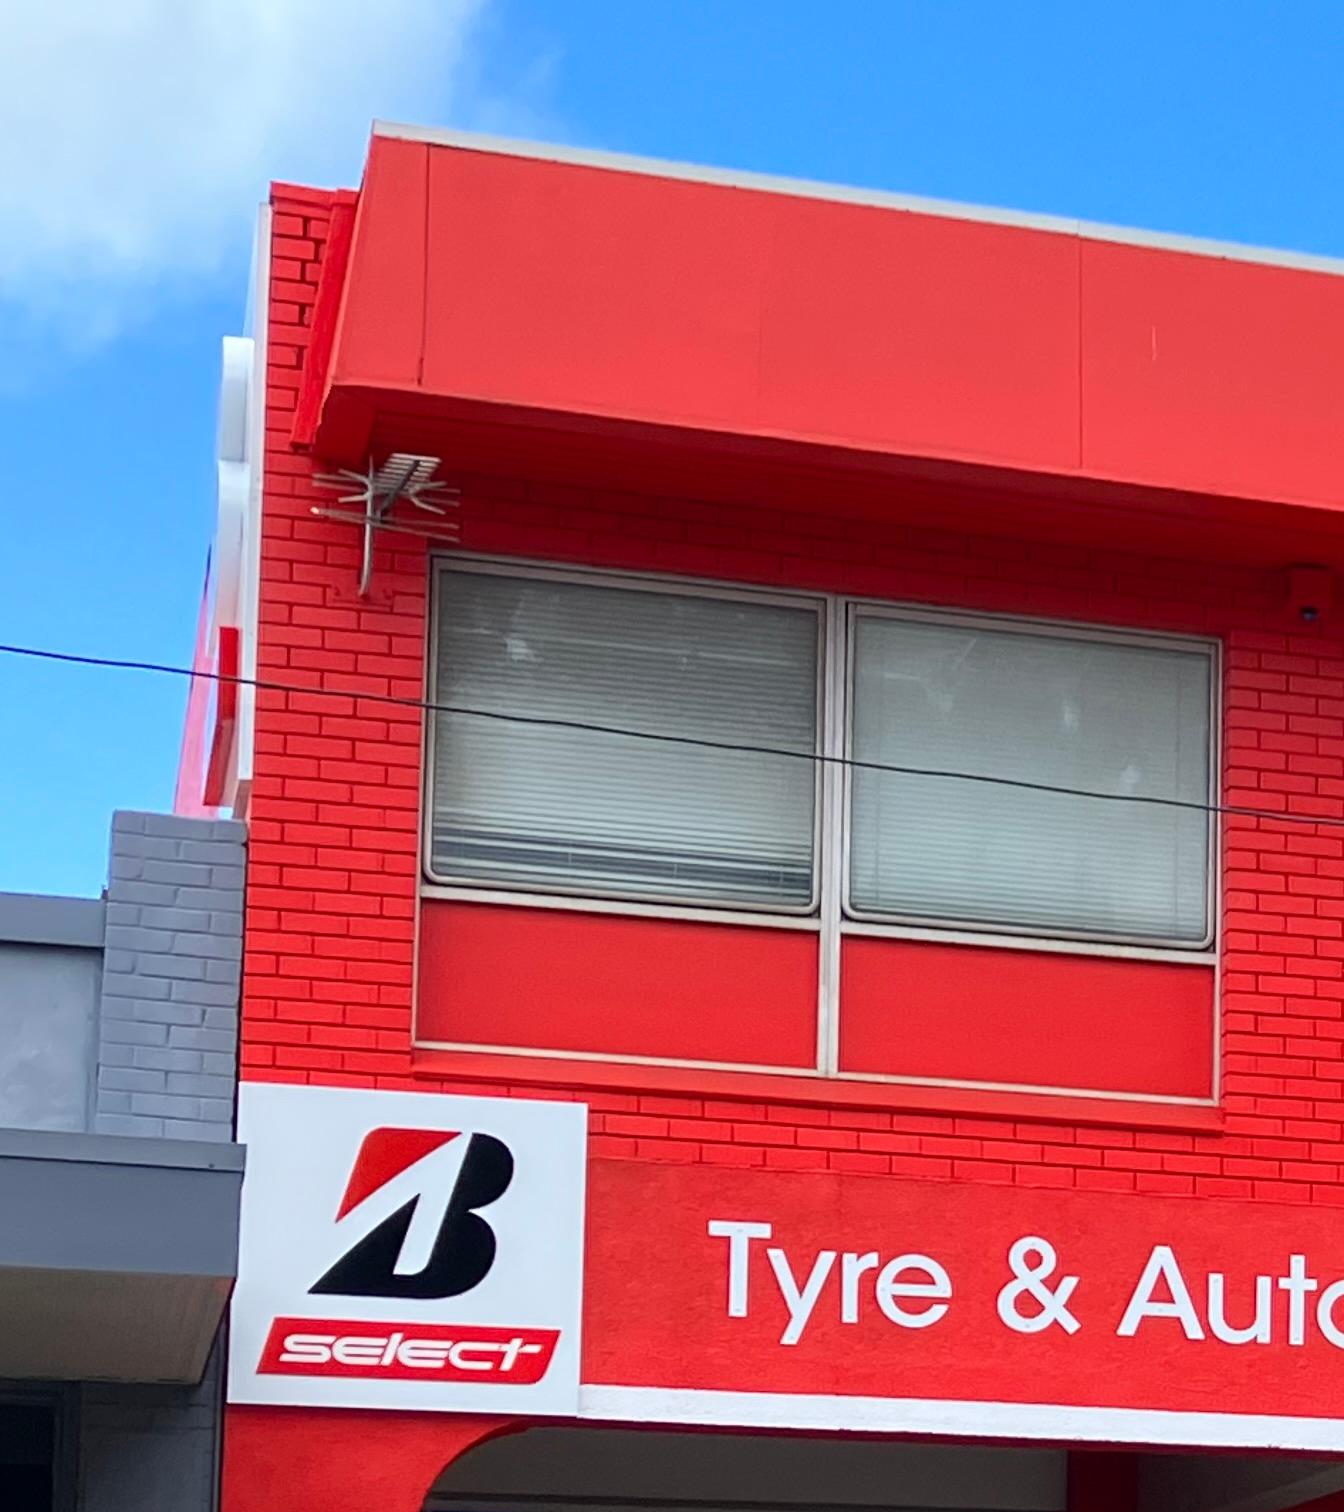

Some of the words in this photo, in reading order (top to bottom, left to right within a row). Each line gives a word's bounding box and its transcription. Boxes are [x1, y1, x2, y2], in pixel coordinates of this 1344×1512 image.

[709, 1221, 952, 1345] Tyre
[998, 1236, 1081, 1335] &
[279, 1332, 543, 1372] select
